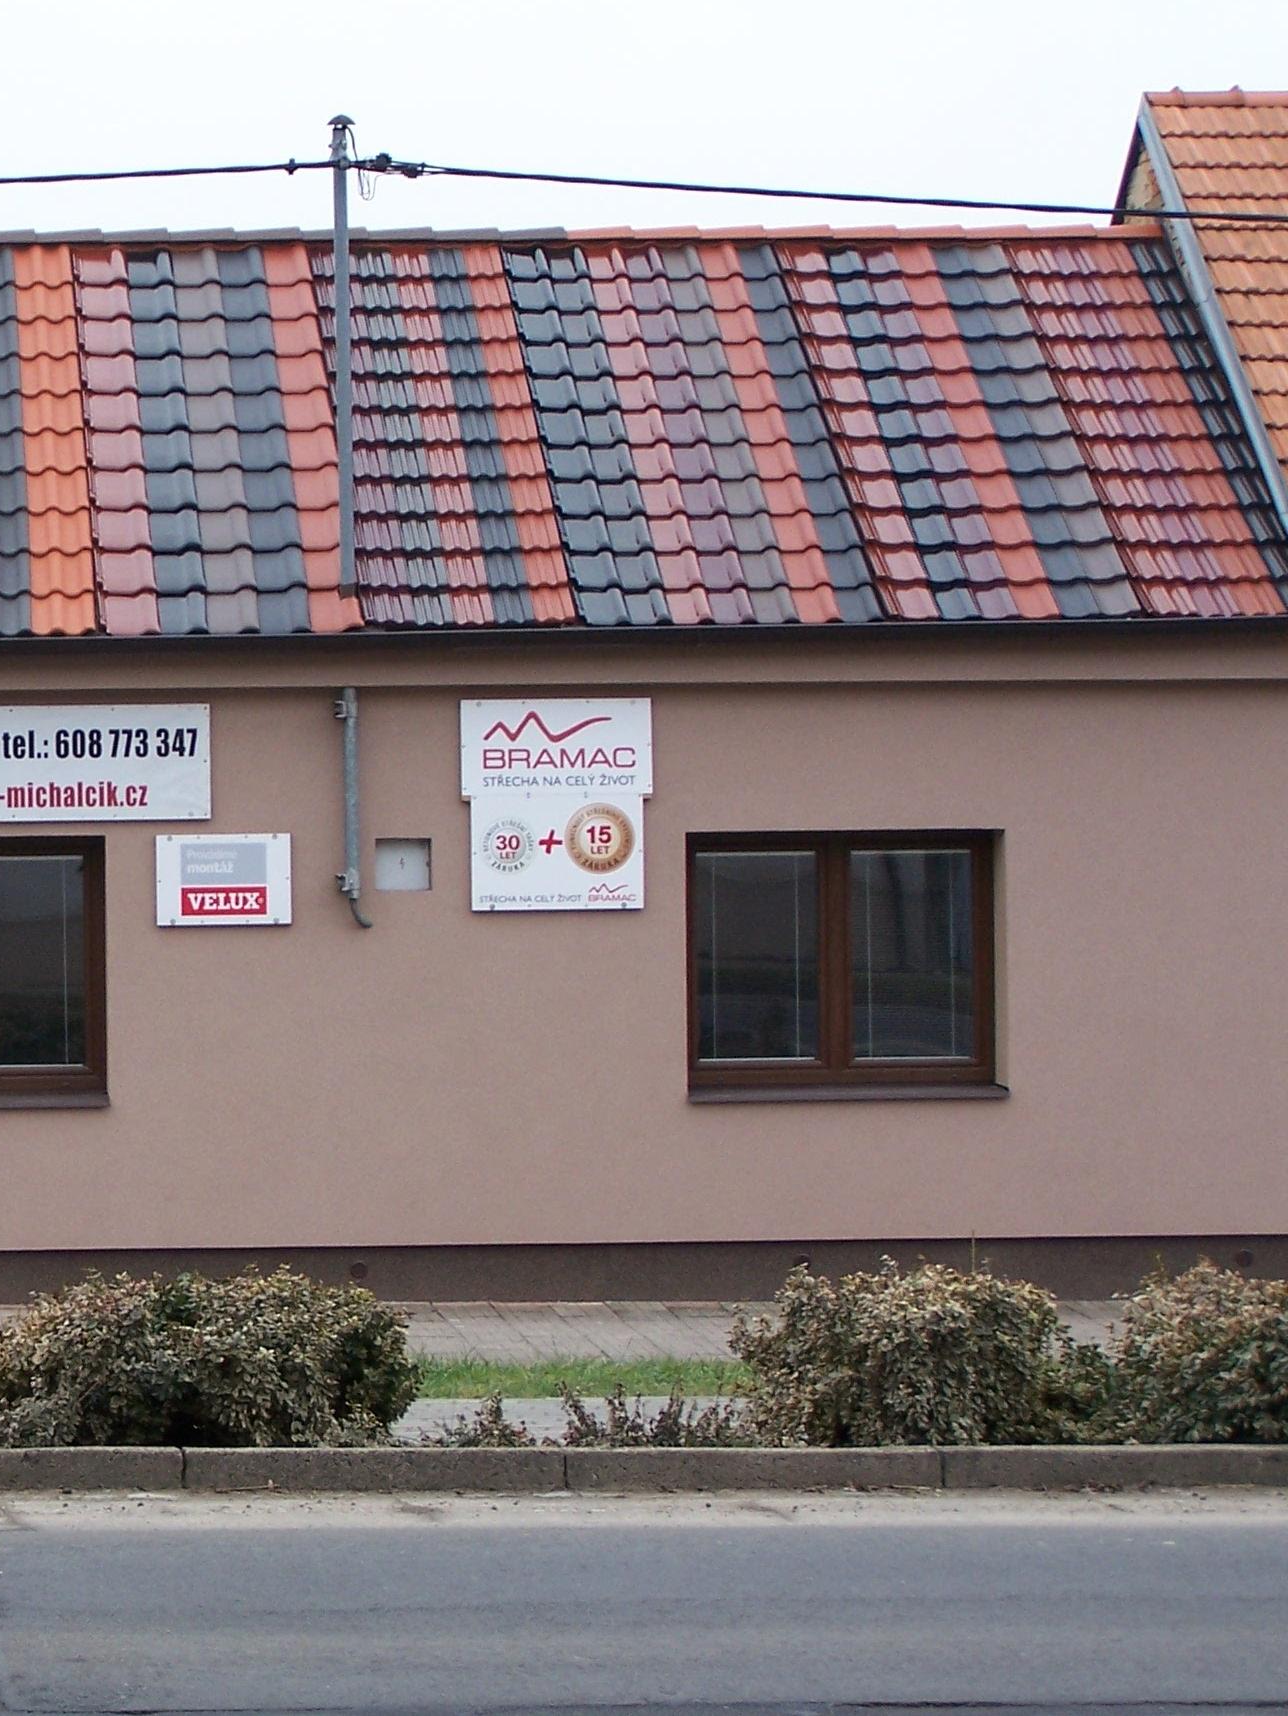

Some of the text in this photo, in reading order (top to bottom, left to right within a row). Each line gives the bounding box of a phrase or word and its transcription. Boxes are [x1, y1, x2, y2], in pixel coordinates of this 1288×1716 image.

[2, 730, 49, 760] tel.:
[55, 729, 102, 759] 608
[109, 729, 149, 758] 773
[156, 728, 199, 758] 347
[483, 747, 637, 769] BRAMAC
[483, 775, 540, 787] STŘECHA
[543, 776, 562, 787] NA
[599, 773, 637, 786] ŽIVOT
[496, 834, 520, 850] 30
[586, 825, 611, 844] 15
[500, 851, 517, 859] LET
[591, 846, 609, 854] LET
[187, 892, 260, 910] VELUX
